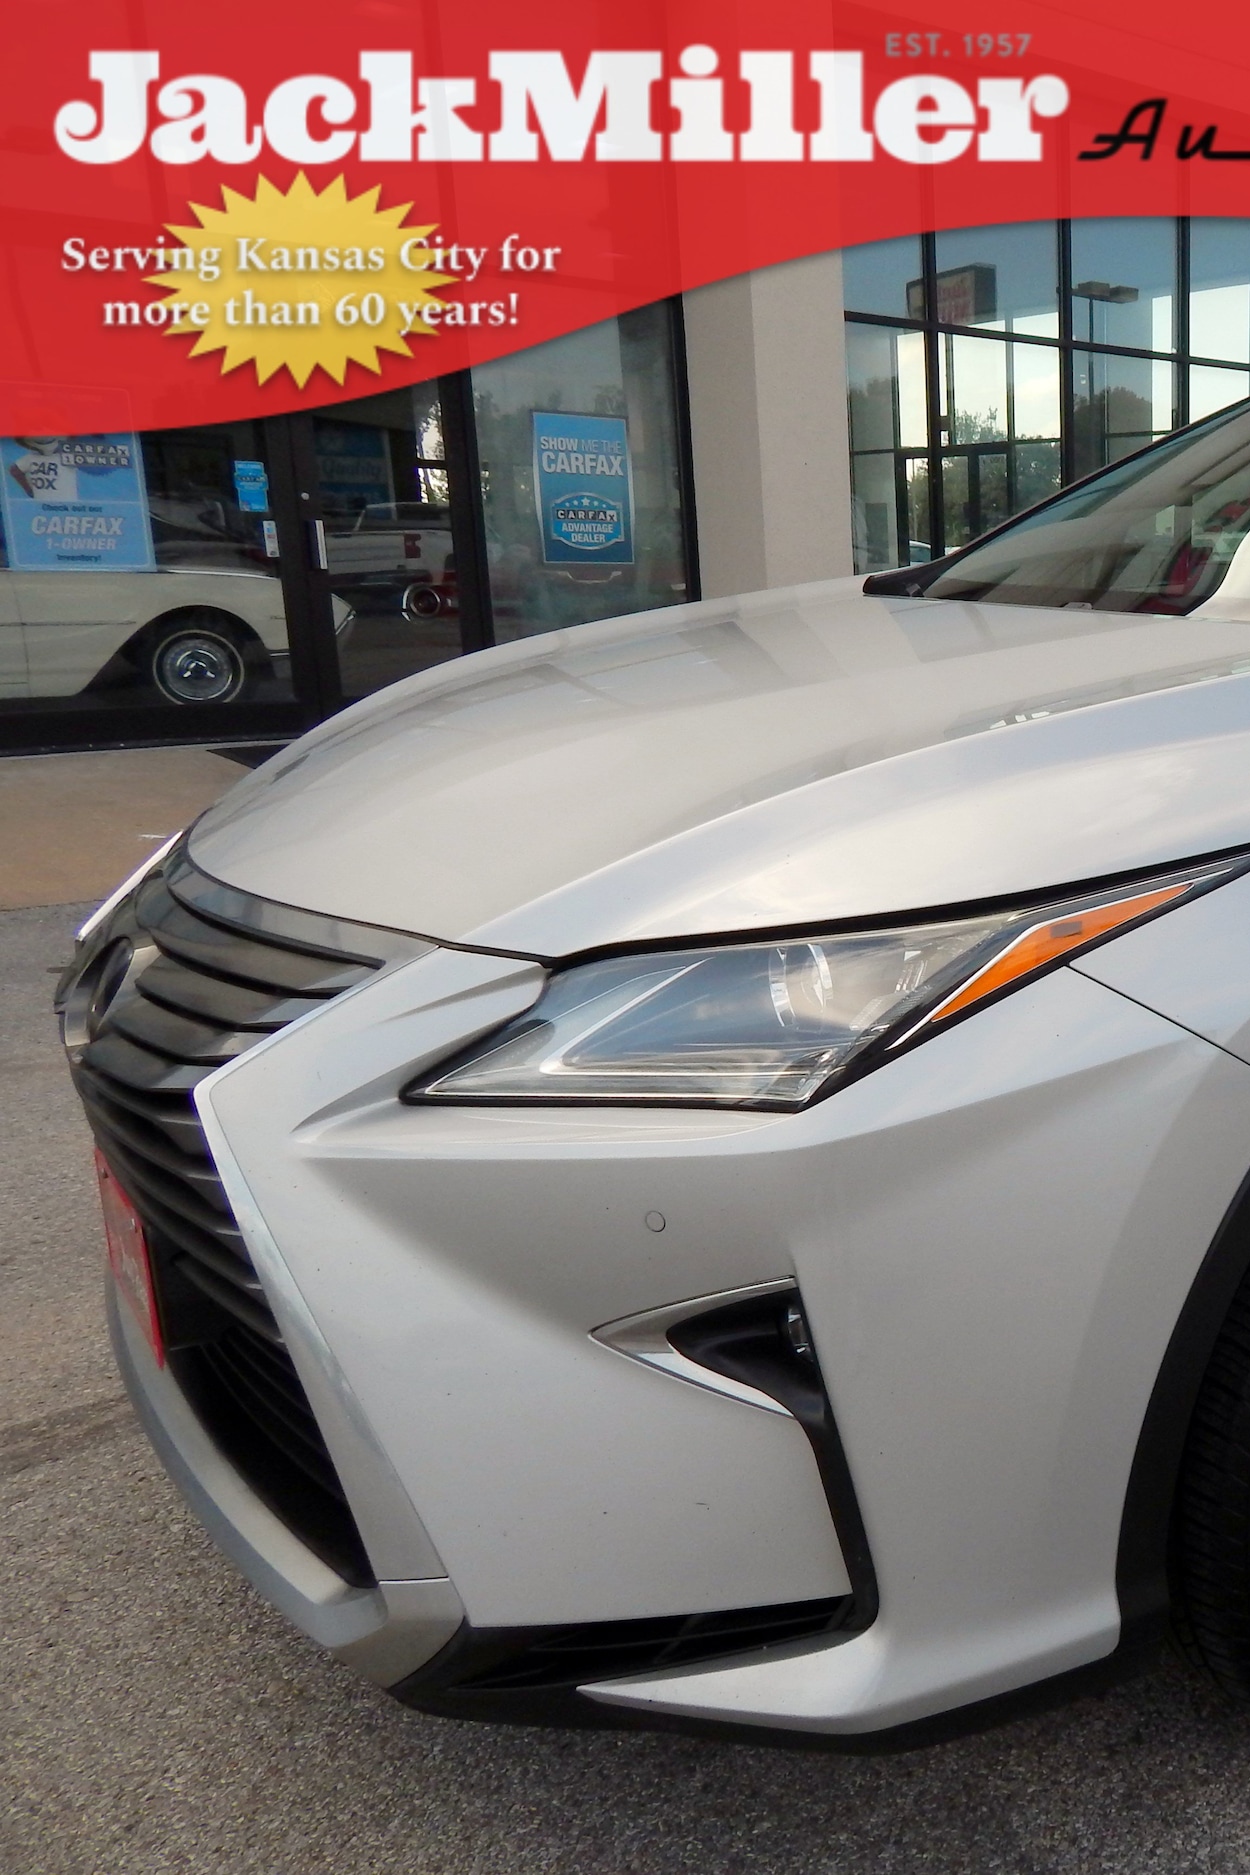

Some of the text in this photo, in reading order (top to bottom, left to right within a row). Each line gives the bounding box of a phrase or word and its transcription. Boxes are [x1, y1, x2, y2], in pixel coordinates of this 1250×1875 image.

[62, 444, 128, 455] CARFAX
[540, 436, 622, 453] SHOW ME THE
[541, 451, 624, 476] CARFAX
[558, 510, 617, 522] CARFAX
[31, 515, 124, 535] CARFAX
[562, 523, 614, 534] ADVANTAGE
[571, 533, 606, 543] DEALER
[47, 538, 117, 551] 1-OWNER
